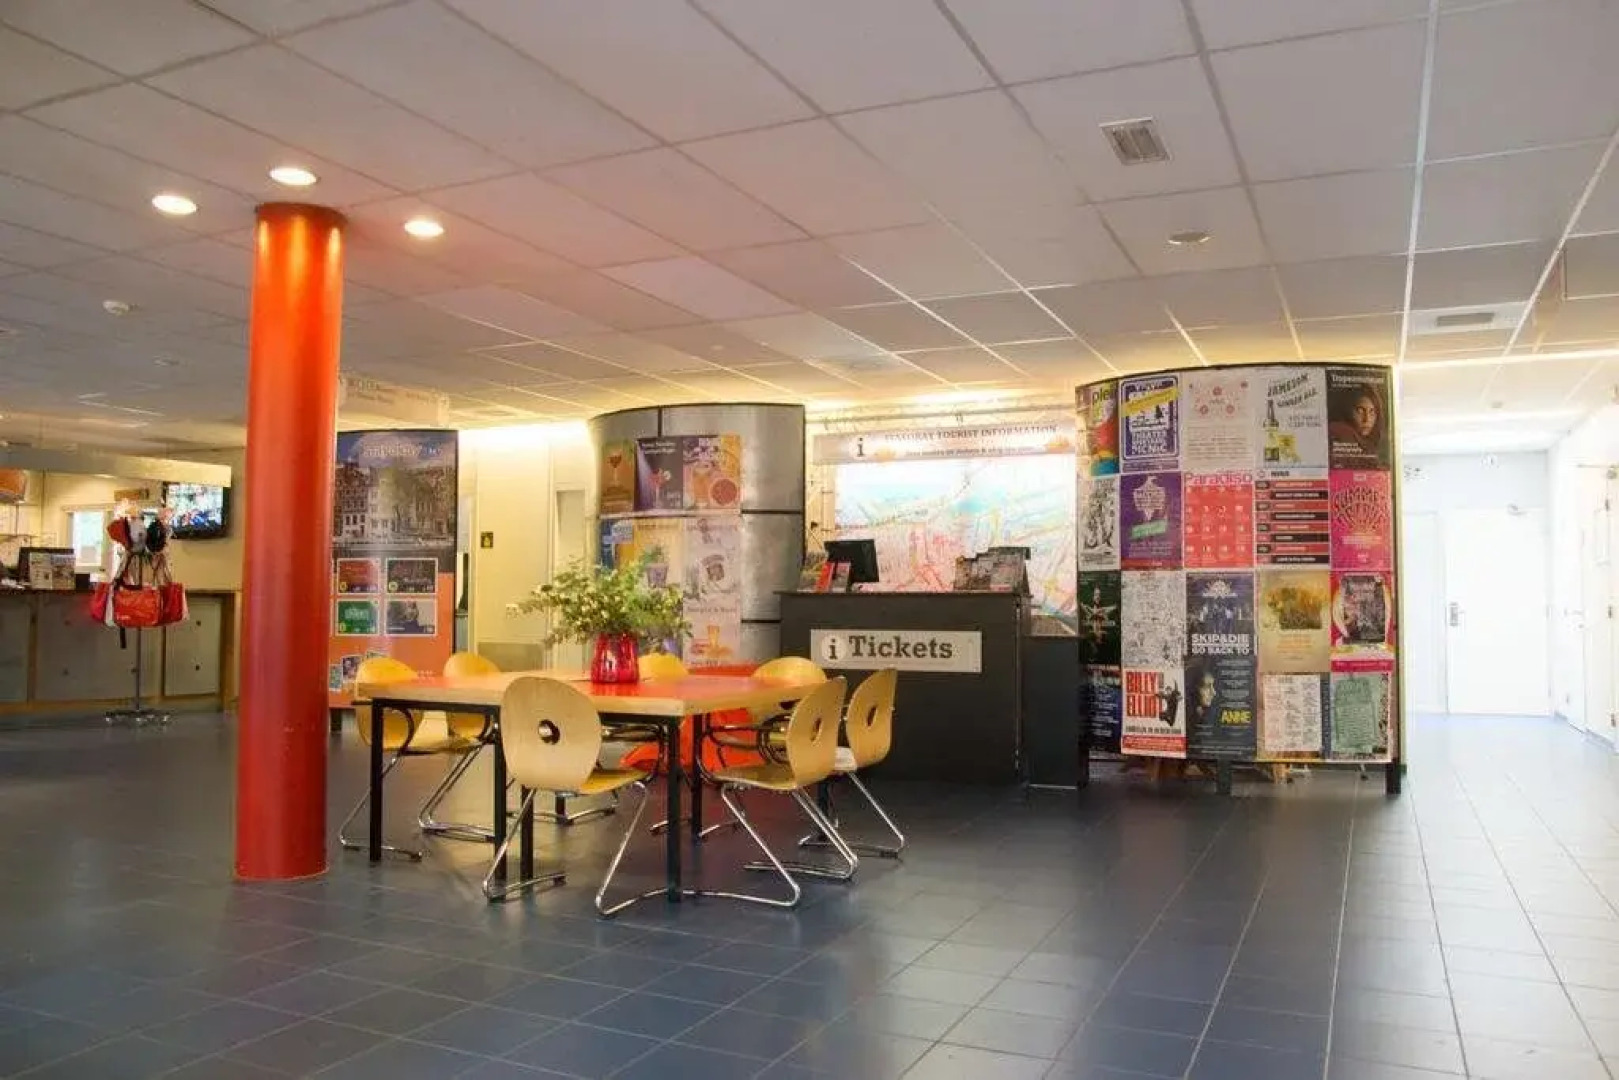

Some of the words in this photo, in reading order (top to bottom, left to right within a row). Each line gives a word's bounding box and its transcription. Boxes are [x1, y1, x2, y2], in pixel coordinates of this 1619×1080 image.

[1267, 373, 1309, 398] JAMESON
[937, 428, 978, 440] TOURIST
[981, 423, 1058, 437] INFORMATION
[857, 437, 865, 458] i
[1184, 472, 1253, 485] Paradiso
[828, 638, 838, 661] i
[848, 634, 953, 659] Tickets
[1126, 671, 1157, 693] BILLY
[1221, 709, 1252, 725] ANNE
